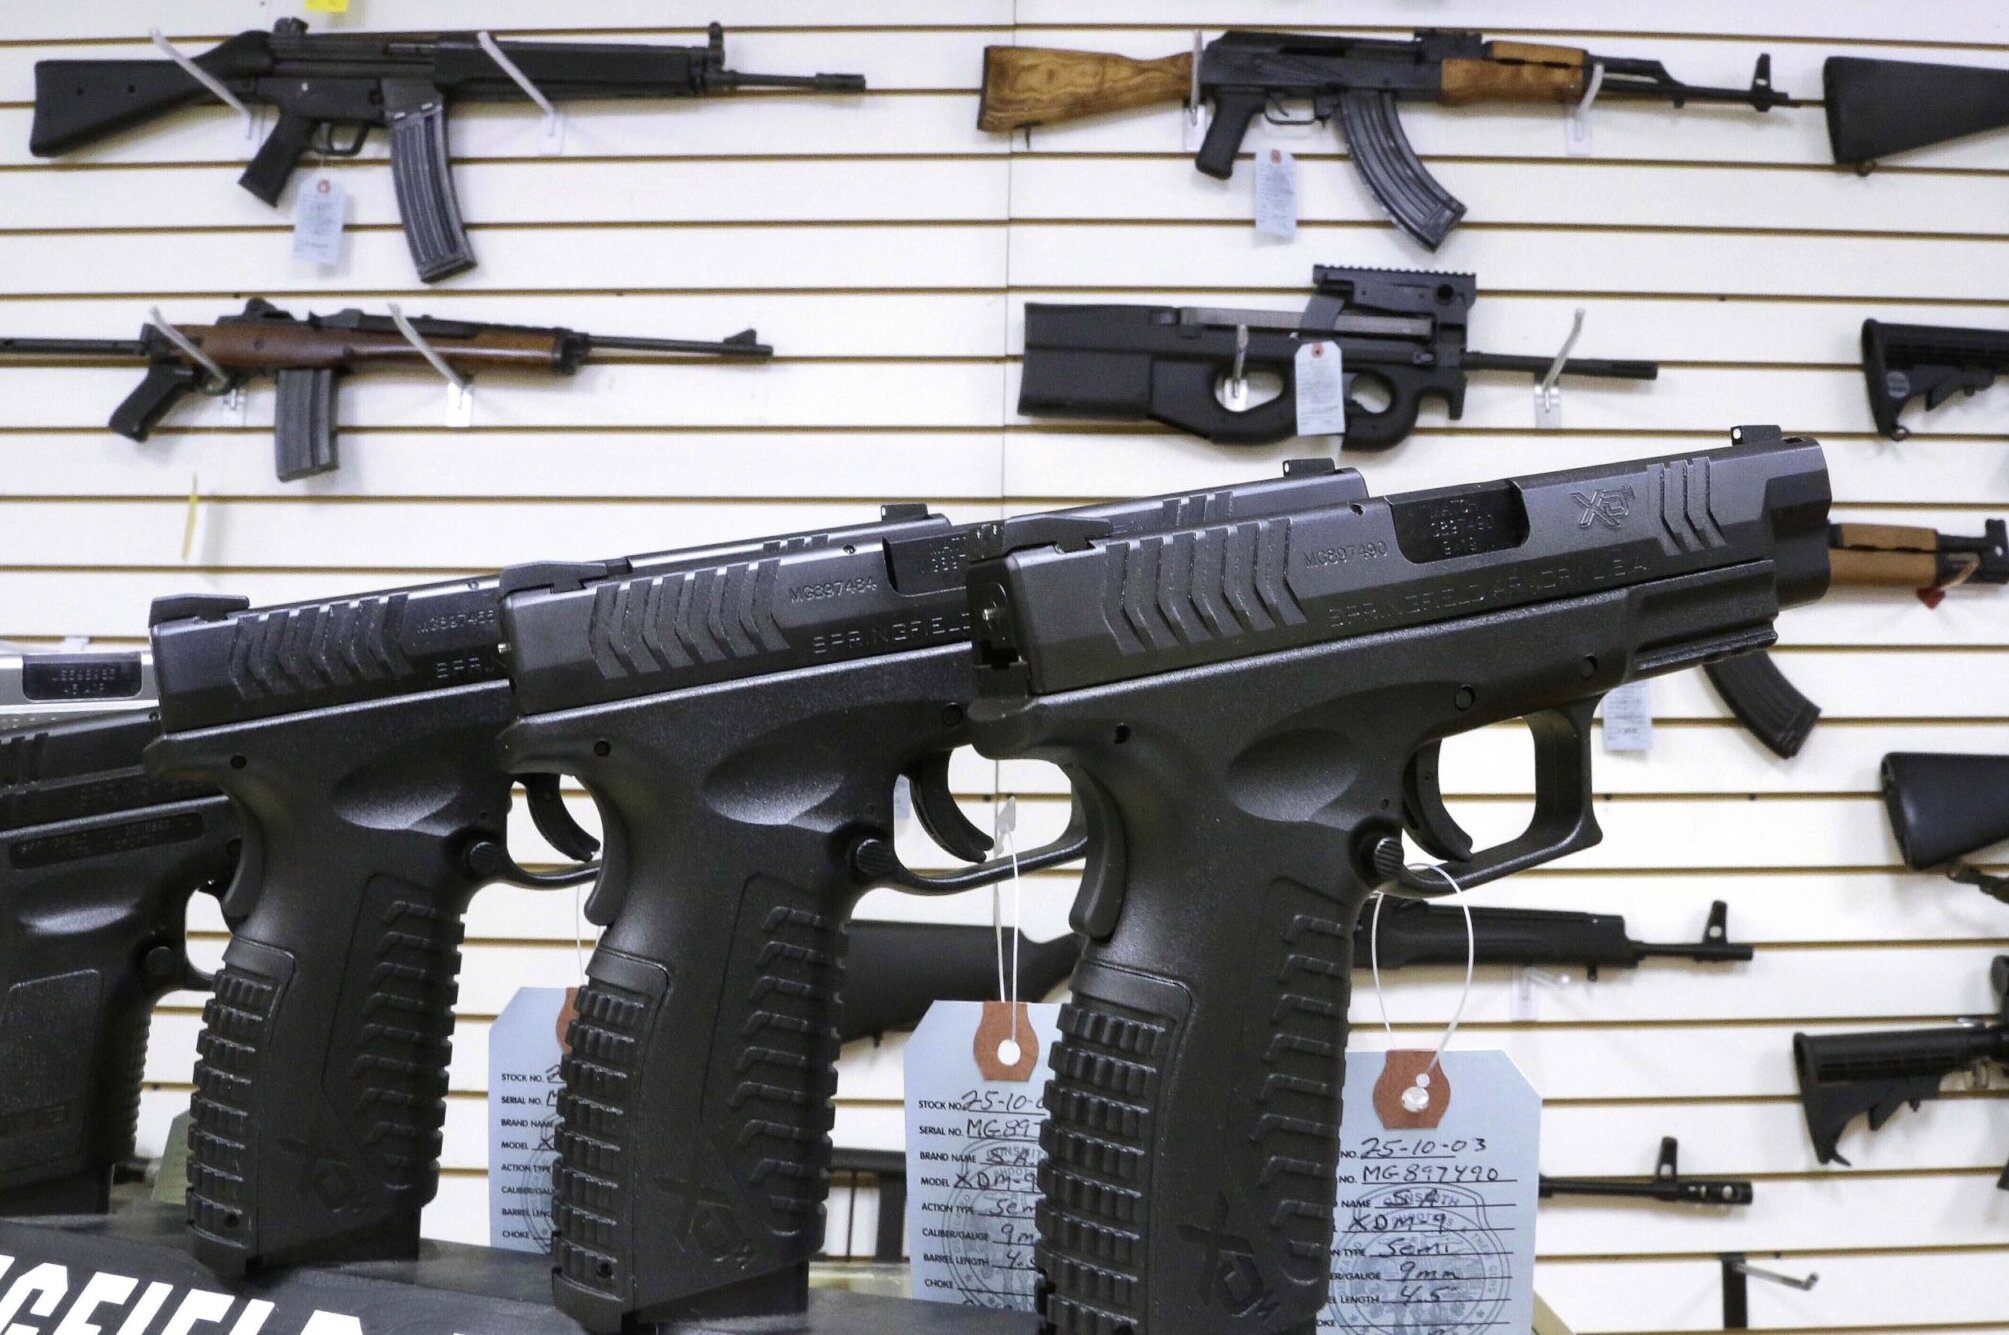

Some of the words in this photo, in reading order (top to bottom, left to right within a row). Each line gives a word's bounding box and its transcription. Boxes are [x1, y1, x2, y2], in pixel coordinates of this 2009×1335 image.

[501, 1073, 527, 1082] STOCK
[501, 1096, 526, 1104] SERIAL
[918, 1100, 946, 1110] STOCK
[501, 1119, 528, 1127] BRAND
[919, 1125, 945, 1136] SERIAL
[501, 1141, 528, 1150] MODEL
[1361, 1137, 1487, 1159] 25-10-03
[919, 1151, 949, 1161] BRAND
[951, 1154, 976, 1164] NAME
[501, 1163, 531, 1172] ACTION
[1362, 1163, 1500, 1184] MG897490
[921, 1177, 950, 1188] MODEL
[921, 1202, 953, 1213] ACTION
[956, 1205, 975, 1216] TYPE
[1341, 1200, 1371, 1209] NAME
[502, 1230, 529, 1239] CHOKE
[922, 1228, 990, 1243] CALIBER/GAUGE
[1343, 1247, 1366, 1257] TYPE
[1378, 1237, 1450, 1258] Semi
[923, 1253, 954, 1265] BARREL
[955, 1257, 990, 1267] LENGTH
[1400, 1261, 1462, 1282] 9mm
[924, 1278, 954, 1289] CHOKE
[1341, 1295, 1380, 1305] LENGTH
